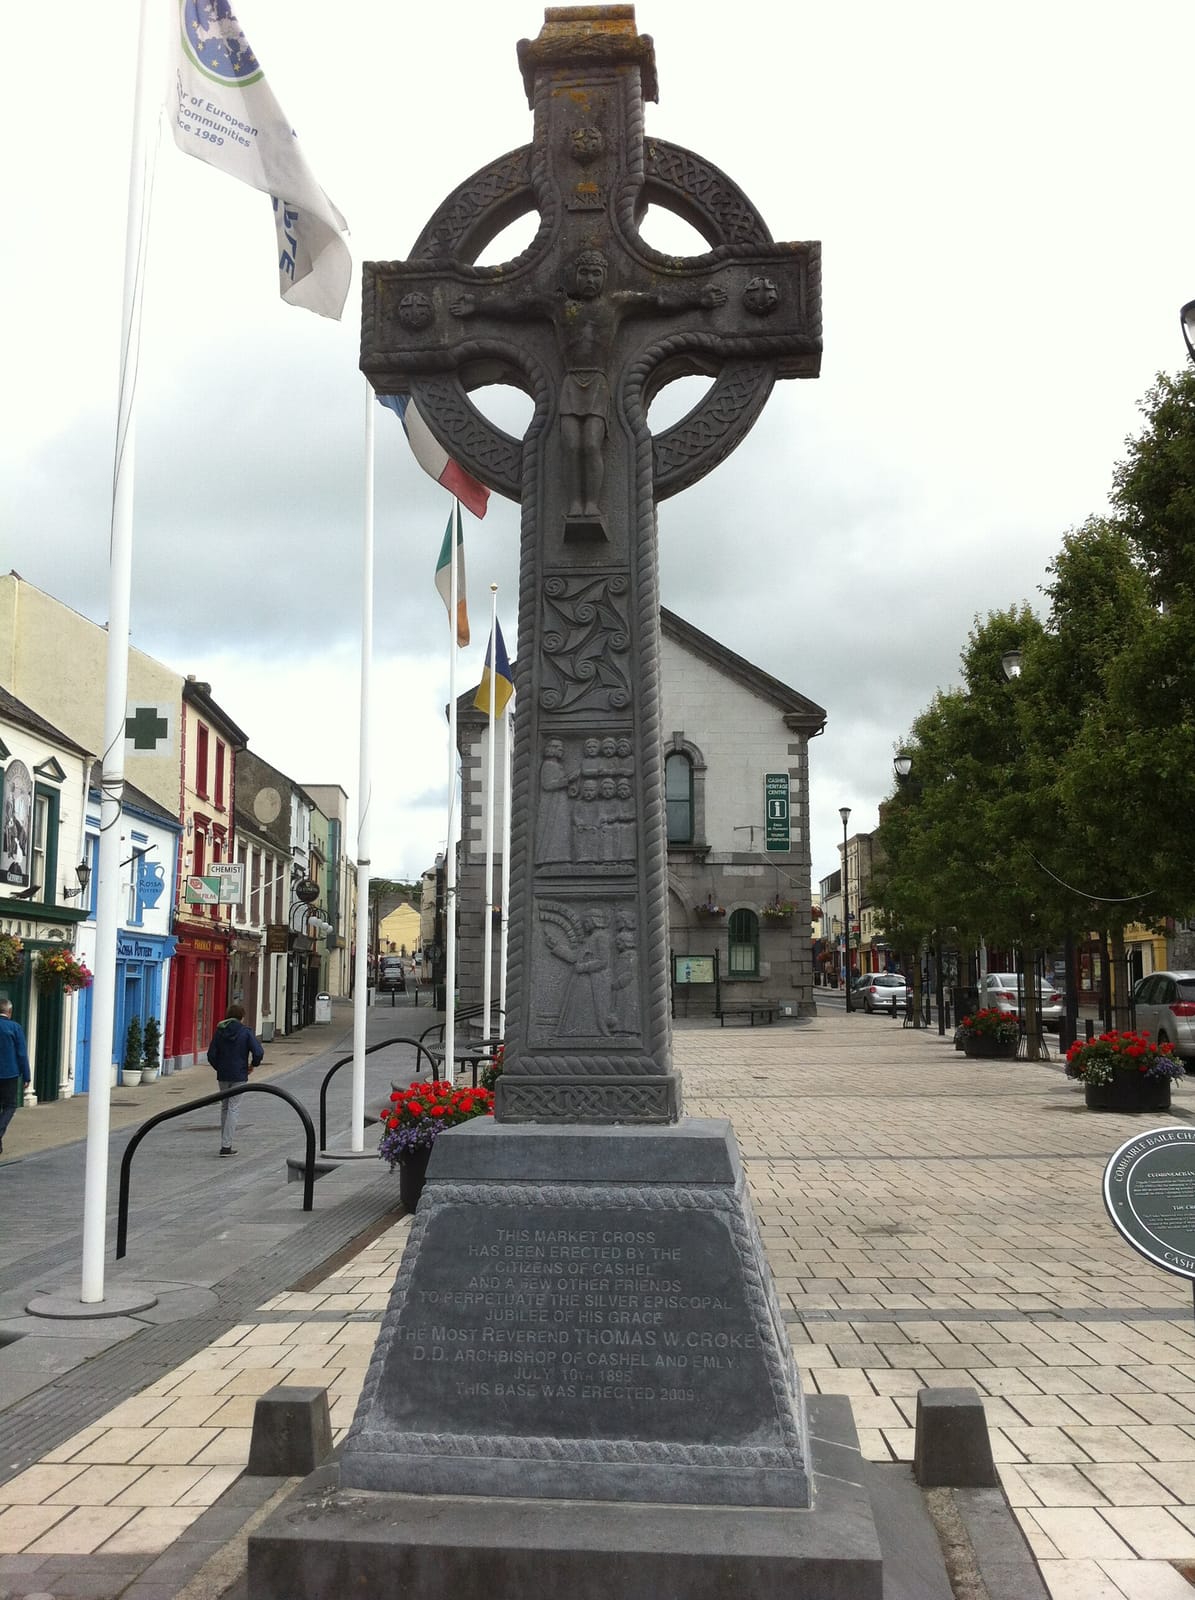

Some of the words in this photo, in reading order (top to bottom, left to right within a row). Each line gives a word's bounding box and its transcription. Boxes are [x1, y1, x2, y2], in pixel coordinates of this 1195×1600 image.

[180, 103, 251, 147] Communities
[191, 97, 204, 107] of
[206, 102, 258, 136] European
[194, 128, 224, 146] 1989
[211, 866, 241, 874] CHEMIST
[140, 880, 161, 888] ROSSA
[1113, 1141, 1148, 1182] COMHAIRLE
[1146, 1132, 1176, 1146] BAILE
[496, 1229, 530, 1241] THIS
[534, 1230, 598, 1243] MARKET
[602, 1231, 656, 1244] CROSS
[468, 1244, 500, 1258] HAS
[504, 1245, 545, 1258] BEEN
[549, 1247, 621, 1260] ERECTED
[626, 1247, 649, 1260] BY
[651, 1247, 681, 1260] THE
[495, 1261, 563, 1275] CITIZENS
[567, 1262, 590, 1275] OF
[592, 1262, 655, 1276] CASHEL
[468, 1276, 501, 1289] AND
[504, 1277, 516, 1289] A
[519, 1278, 552, 1290] FEW
[557, 1278, 610, 1291] OTHER
[614, 1280, 681, 1293] FRIENDS
[419, 1290, 440, 1304] TO
[443, 1292, 545, 1306] PERPETUATE
[550, 1294, 580, 1306] THE
[584, 1294, 639, 1309] SILVER
[643, 1295, 733, 1310] EPISCOPAL
[485, 1308, 549, 1322] JUBILEE
[553, 1309, 575, 1322] OF
[579, 1310, 604, 1323] HIS
[608, 1310, 665, 1324] GRACE
[574, 1328, 657, 1346] THOMAS
[454, 1349, 557, 1363] ARCHBISHOP
[561, 1351, 583, 1365] OF
[586, 1352, 650, 1367] CASHEL
[655, 1354, 689, 1368] AND
[513, 1366, 555, 1380] JULY
[455, 1382, 489, 1396] THIS
[494, 1382, 537, 1397] BASE
[541, 1383, 577, 1398] WAS
[581, 1385, 656, 1400] ERECTED
